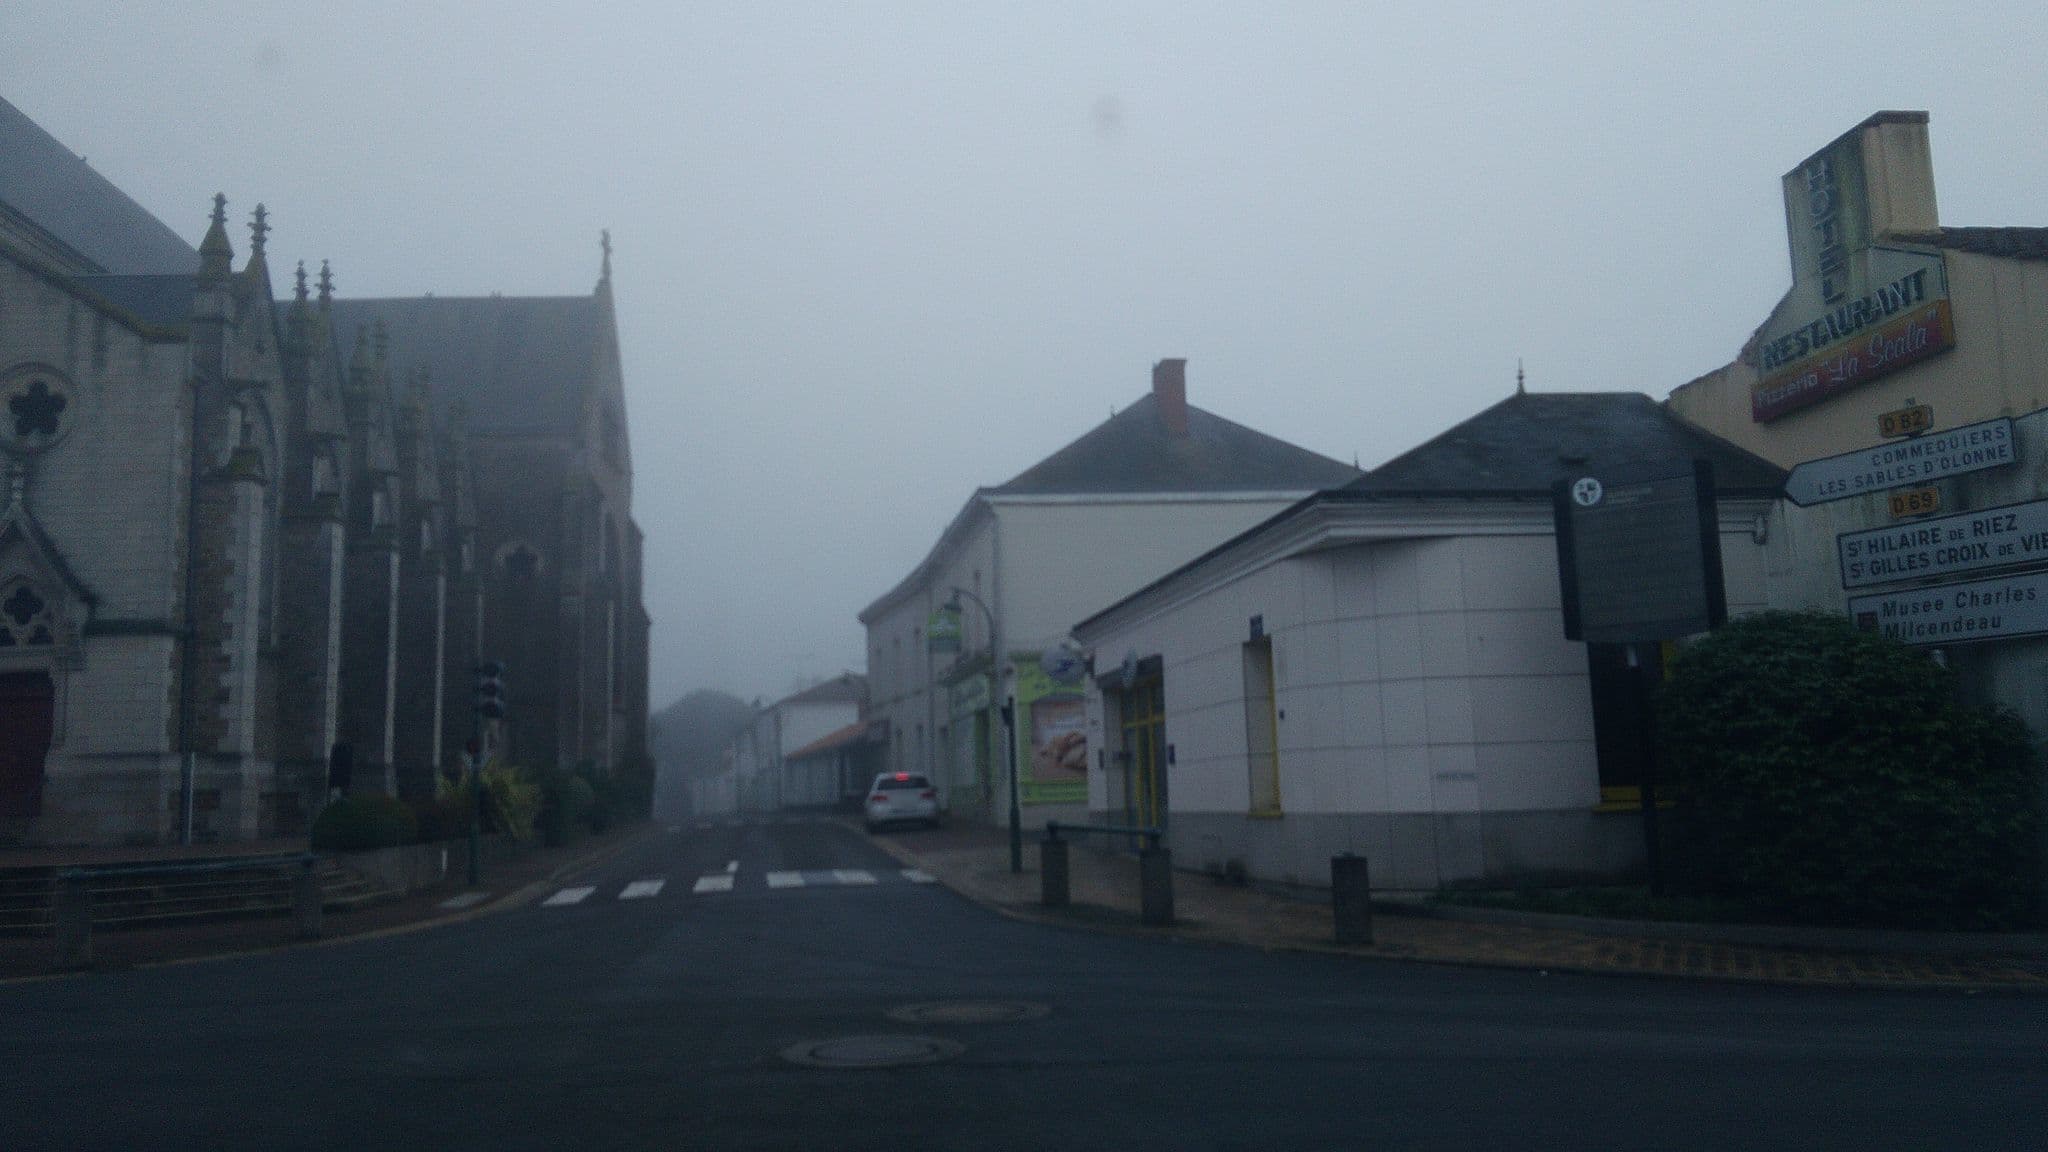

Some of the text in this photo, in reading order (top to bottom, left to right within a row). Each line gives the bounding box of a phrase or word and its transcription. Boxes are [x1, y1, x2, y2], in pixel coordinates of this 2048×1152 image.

[1806, 160, 1846, 305] HOTEL
[1761, 268, 1928, 369] RESTAURANT
[1884, 416, 1896, 433] D
[1871, 425, 2007, 467] COMMEQUIERS
[1819, 445, 2009, 497] LES SABLES D'OLONNE
[1894, 497, 1906, 514] D
[1867, 527, 1943, 555] HILAIRE
[1949, 529, 1965, 541] DE
[1973, 513, 2018, 537] RIEZ
[1870, 552, 1931, 576] GILLES
[1936, 542, 1991, 565] CROIX
[1998, 543, 2016, 556] DE
[1955, 586, 2037, 609] Charles
[1885, 615, 2002, 640] Milcendeau
